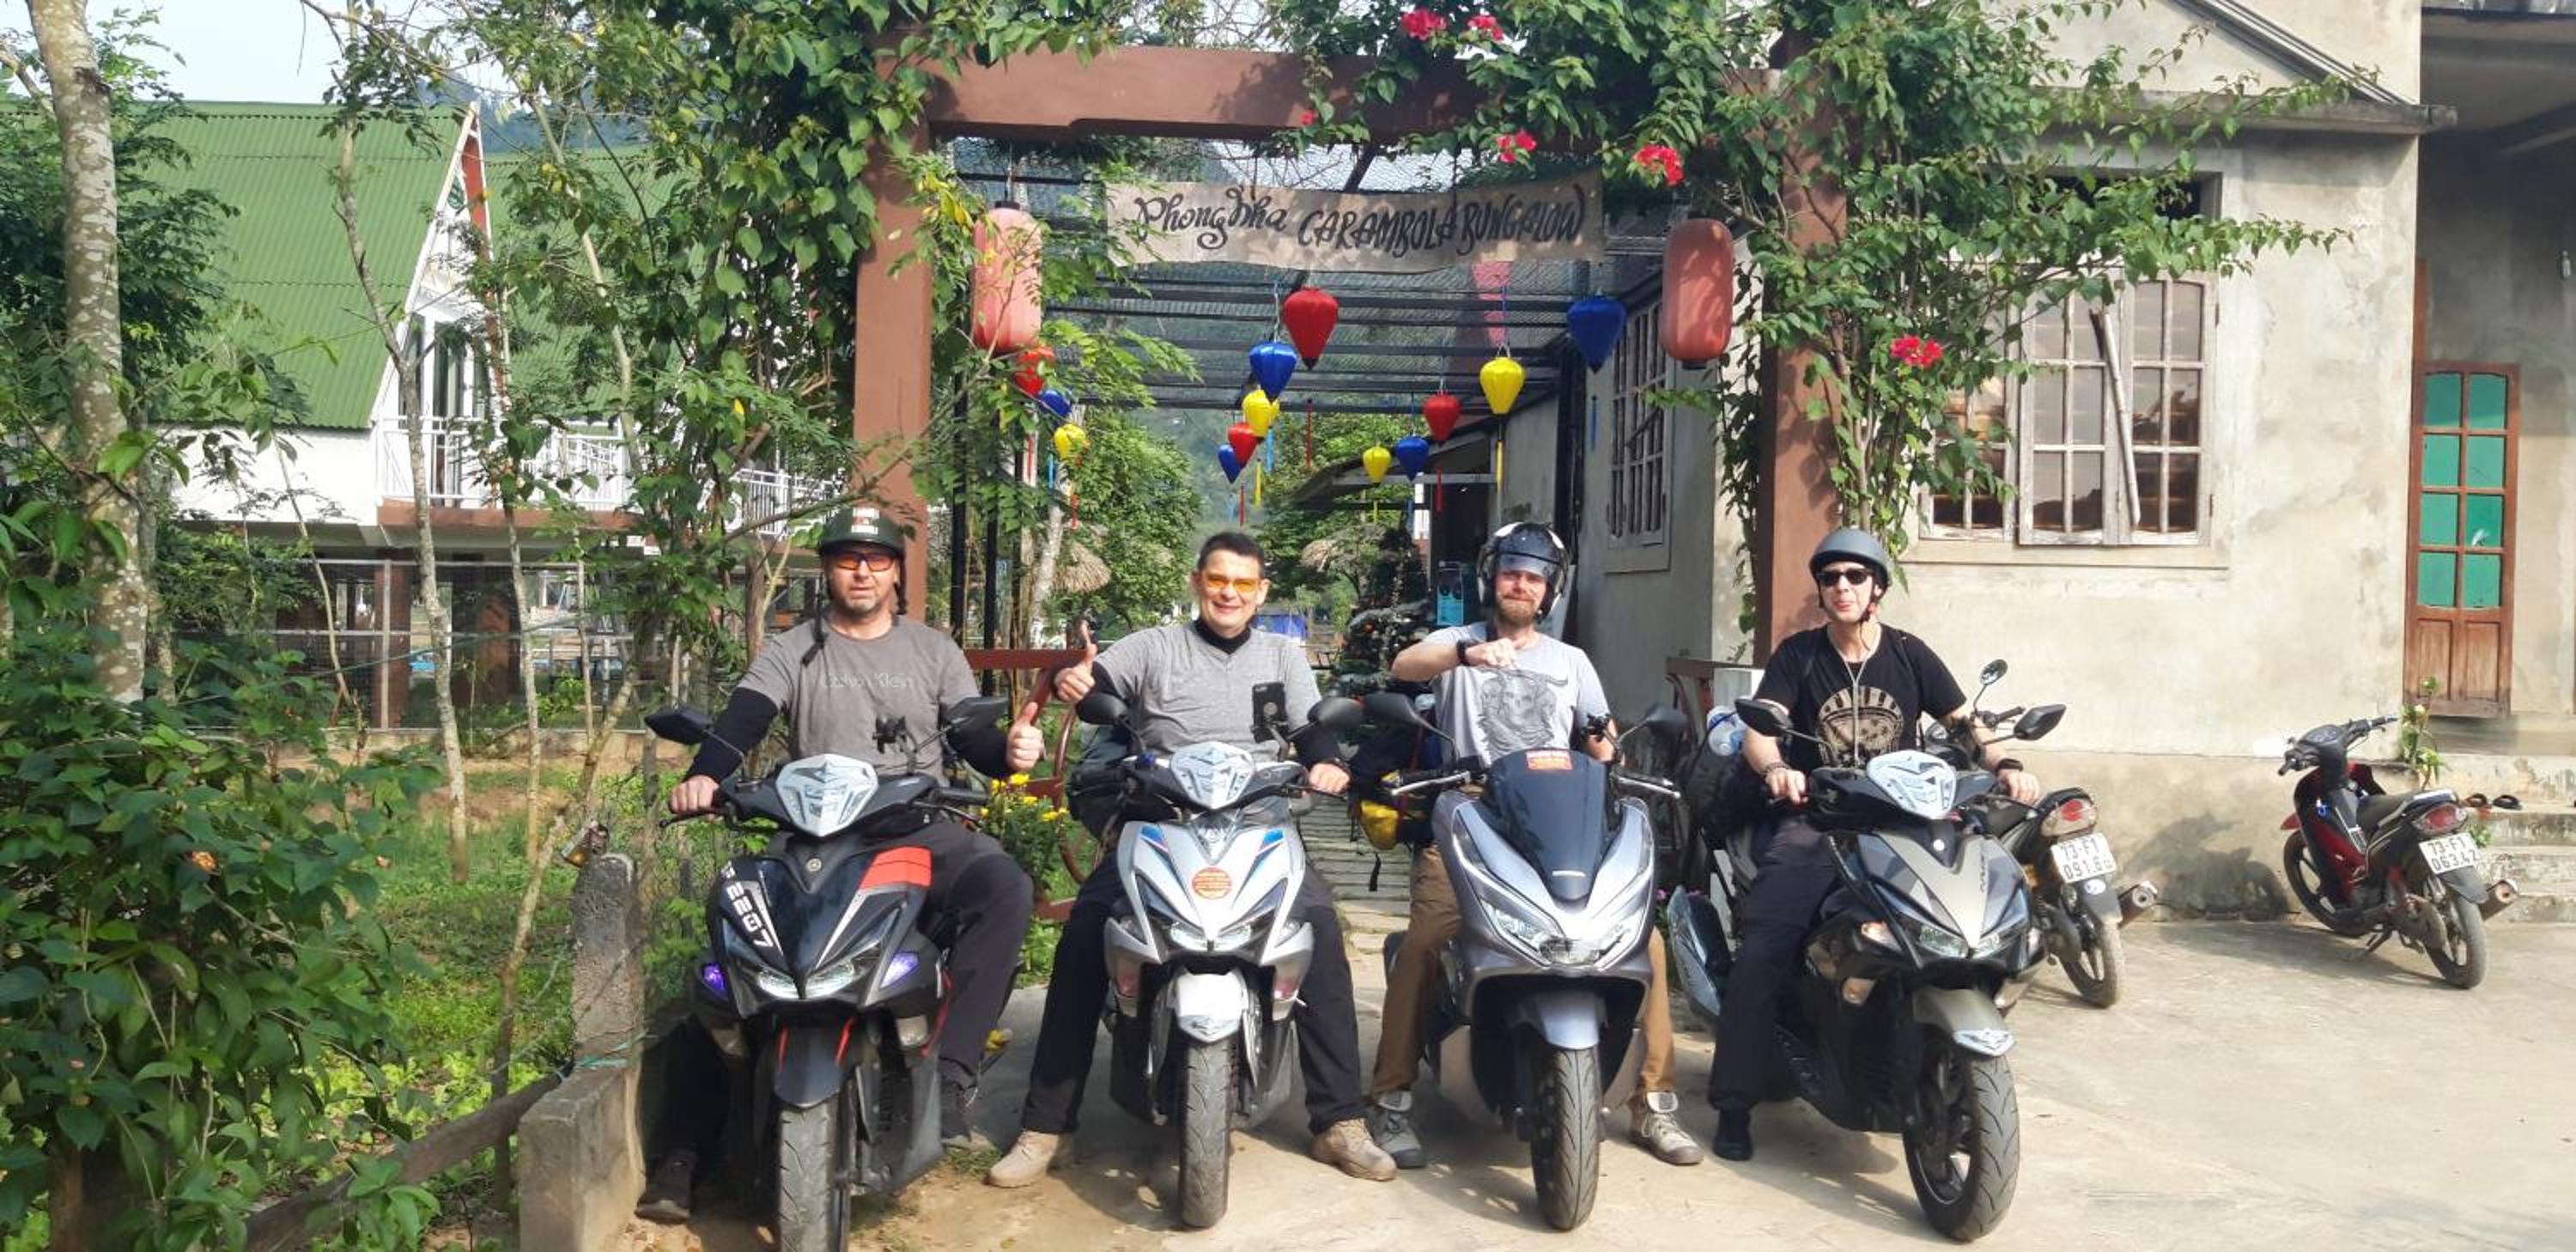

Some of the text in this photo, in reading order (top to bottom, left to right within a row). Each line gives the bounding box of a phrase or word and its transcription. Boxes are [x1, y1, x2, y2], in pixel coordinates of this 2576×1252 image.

[1133, 193, 1229, 250] Phong
[1297, 207, 1456, 258] CARAMBOLA
[1455, 183, 1586, 255] BUNGALOW
[2059, 837, 2100, 862] 73-F1
[2427, 836, 2467, 856] 73-F1
